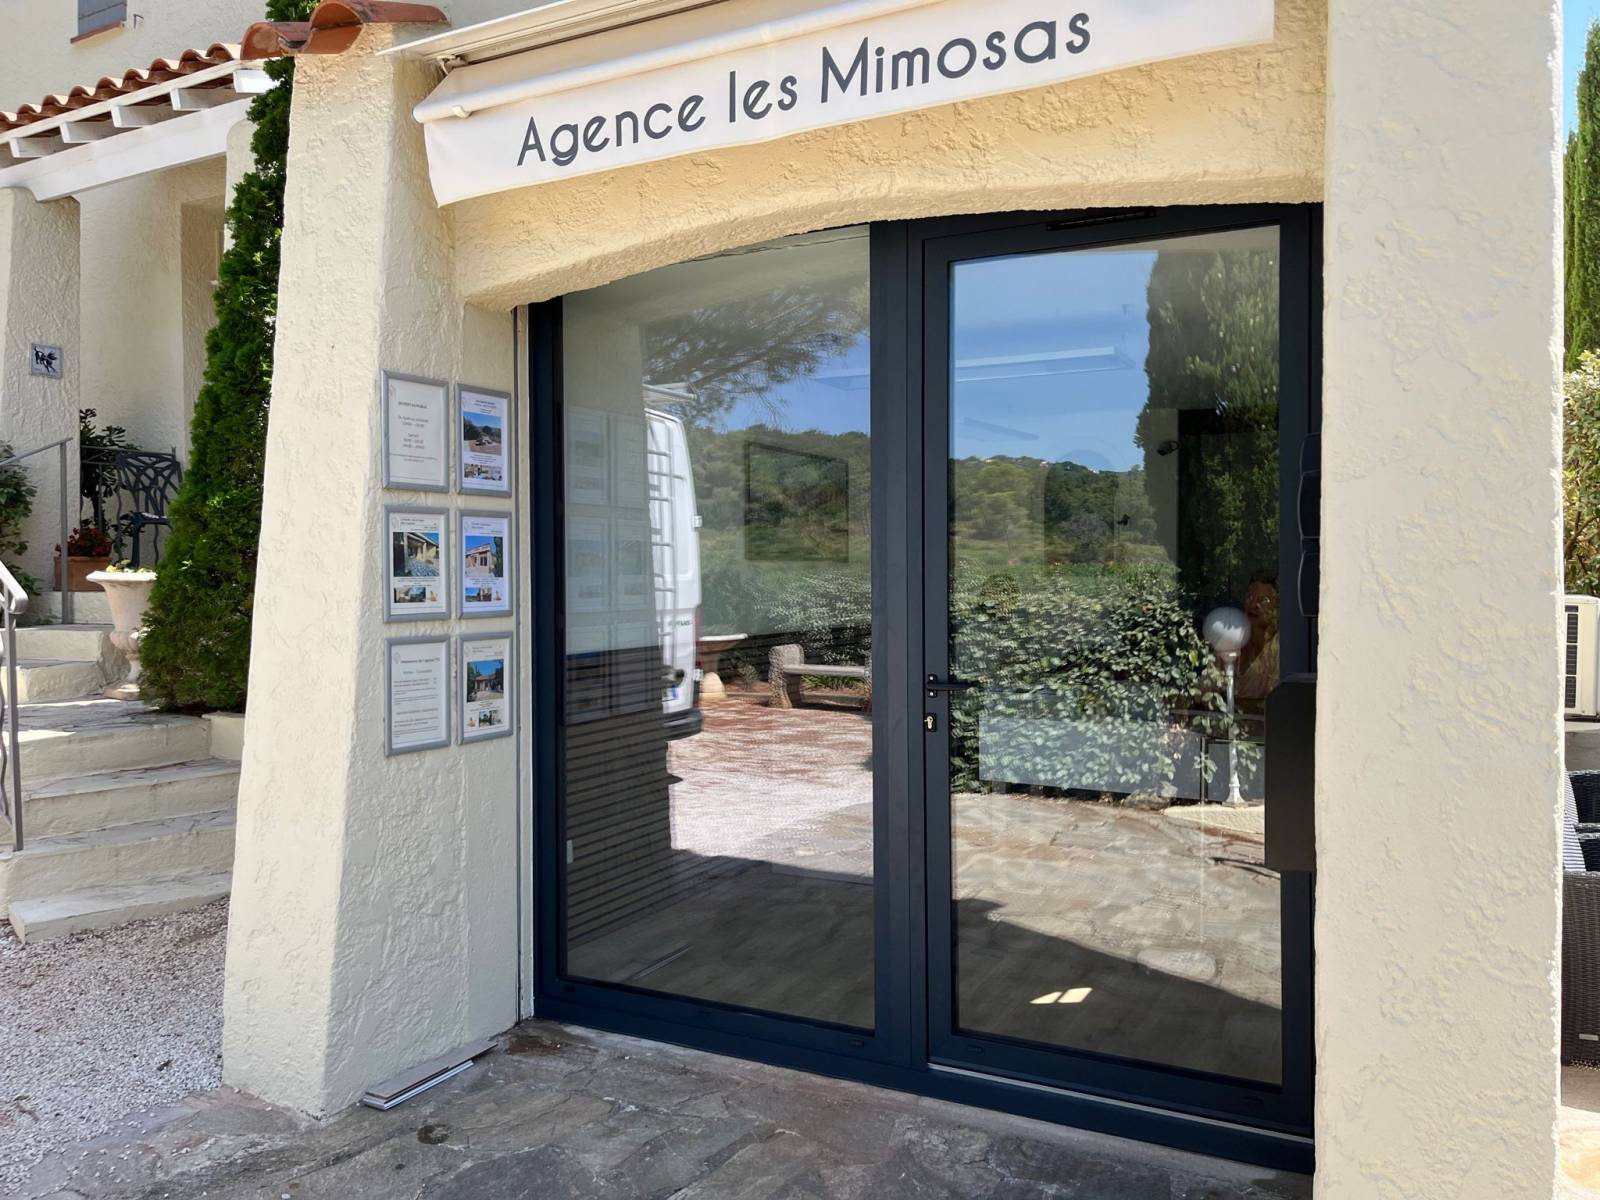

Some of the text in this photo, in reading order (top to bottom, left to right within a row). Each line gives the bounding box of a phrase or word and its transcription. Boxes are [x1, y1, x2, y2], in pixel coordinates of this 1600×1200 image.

[516, 12, 1091, 168] Agence les Mimosas
